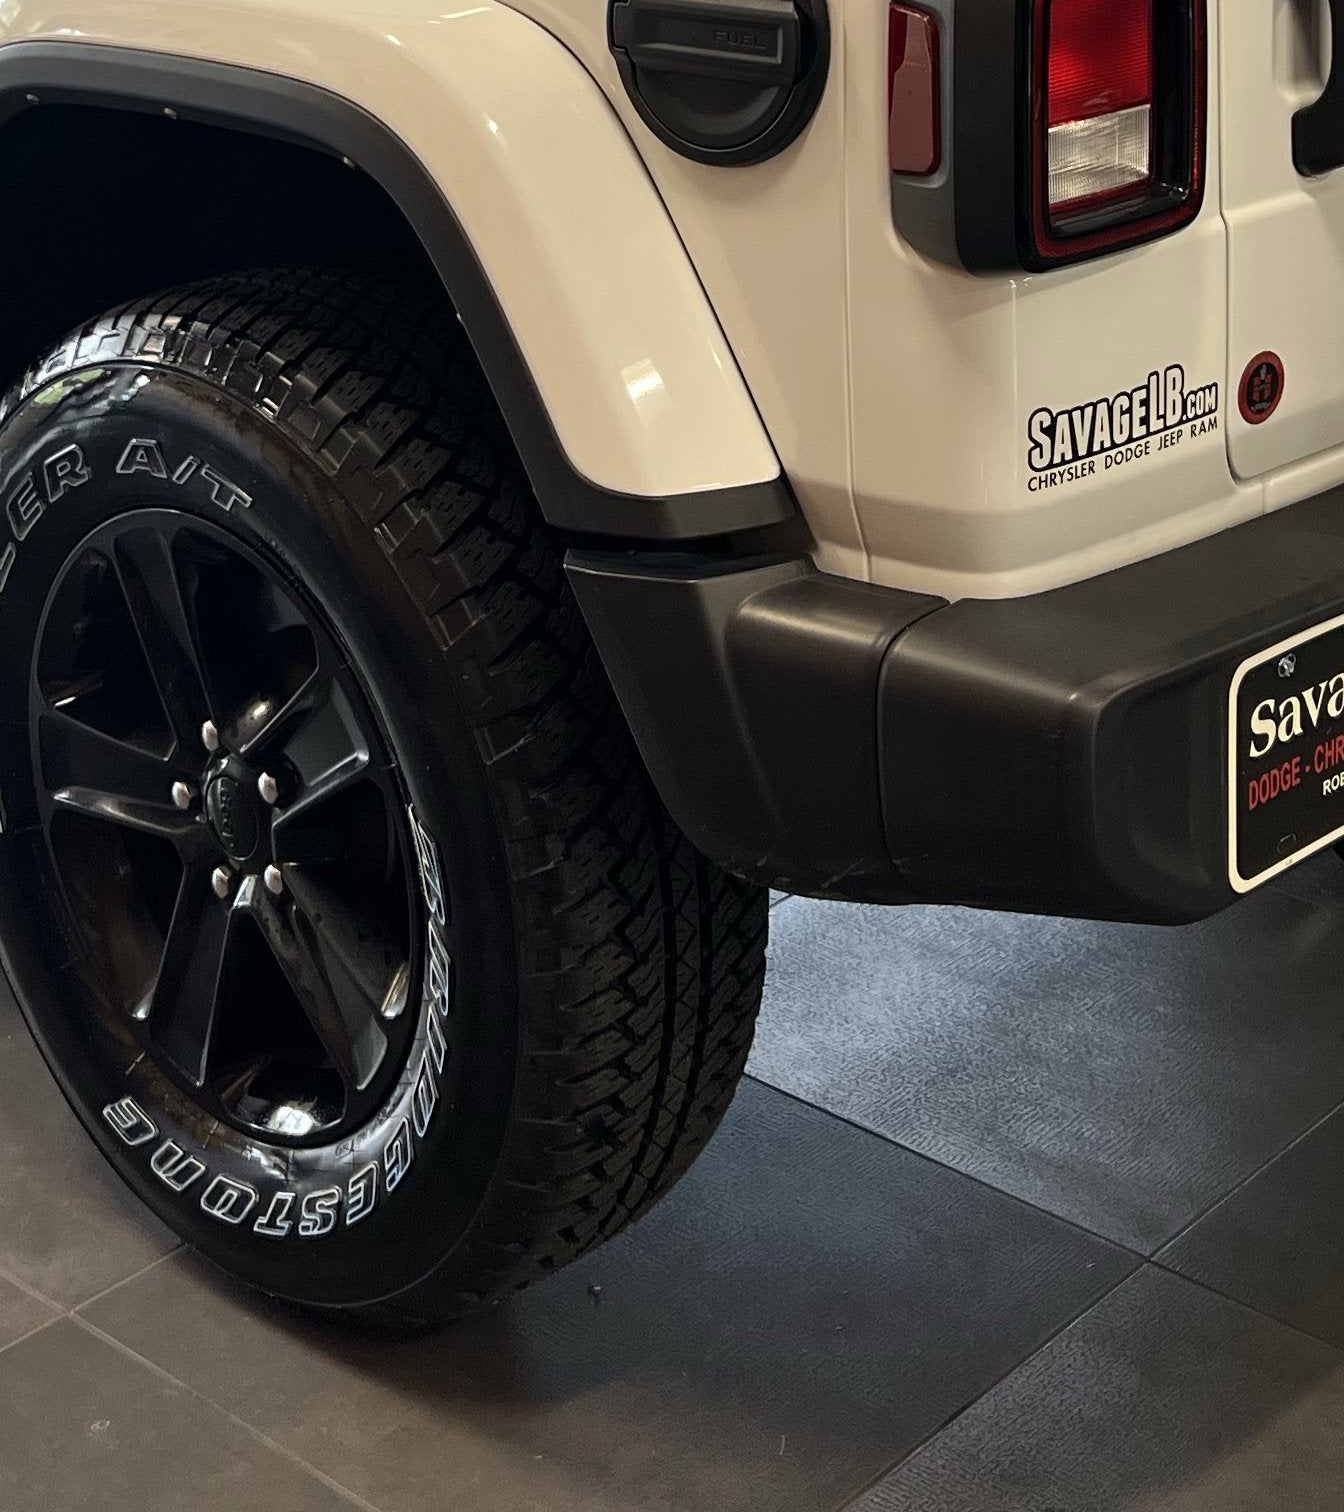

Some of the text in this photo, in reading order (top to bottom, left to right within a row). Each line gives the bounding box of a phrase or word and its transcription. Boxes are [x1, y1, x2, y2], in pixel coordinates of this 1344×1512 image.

[712, 31, 767, 49] FUEL
[1027, 415, 1218, 492] CHRYSLER DODGE JEEP RAM
[1248, 756, 1301, 810] DODGE
[102, 804, 451, 1237] BRIDGESTONE
